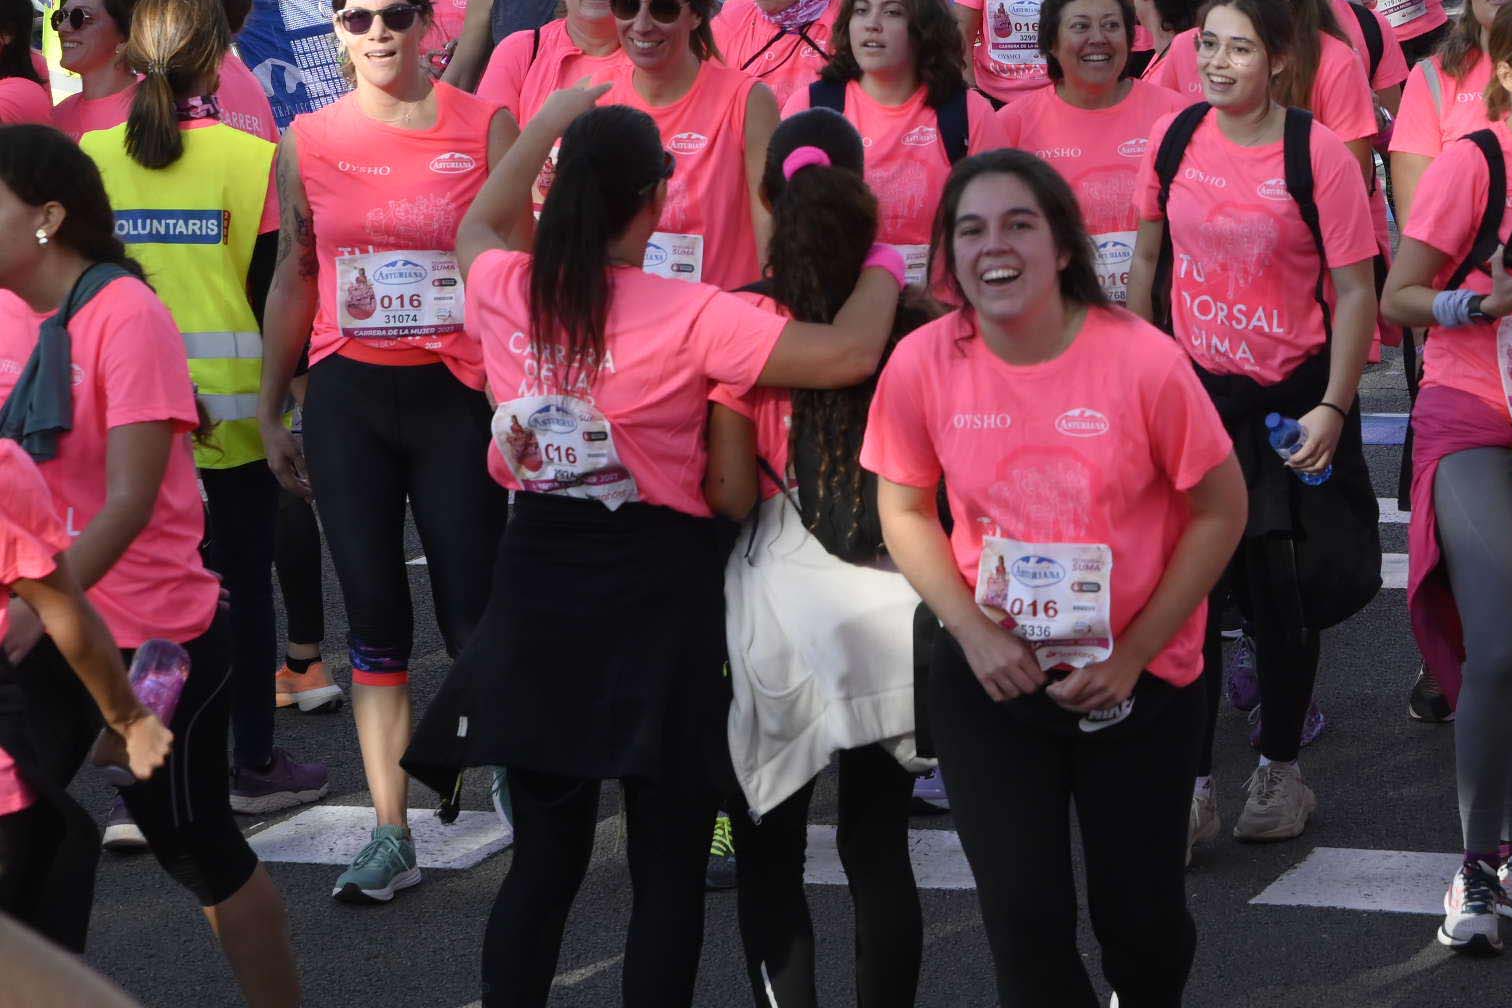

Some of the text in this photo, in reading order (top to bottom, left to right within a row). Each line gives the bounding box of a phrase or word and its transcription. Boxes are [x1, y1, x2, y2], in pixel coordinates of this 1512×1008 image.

[1456, 90, 1483, 105] OYS
[1035, 146, 1082, 161] OYSHO
[113, 218, 219, 236] OLUNTARIS
[1178, 252, 1207, 283] TU
[379, 292, 423, 310] 016
[384, 312, 419, 325] 31074
[1181, 291, 1285, 334] ORSAL
[353, 328, 387, 338] CARRERA
[387, 328, 399, 337] DE
[399, 327, 410, 337] LA
[409, 326, 436, 337] MUJER
[952, 413, 1012, 430] OYSHO
[1009, 597, 1060, 619] 016
[1020, 623, 1052, 638] 5336
